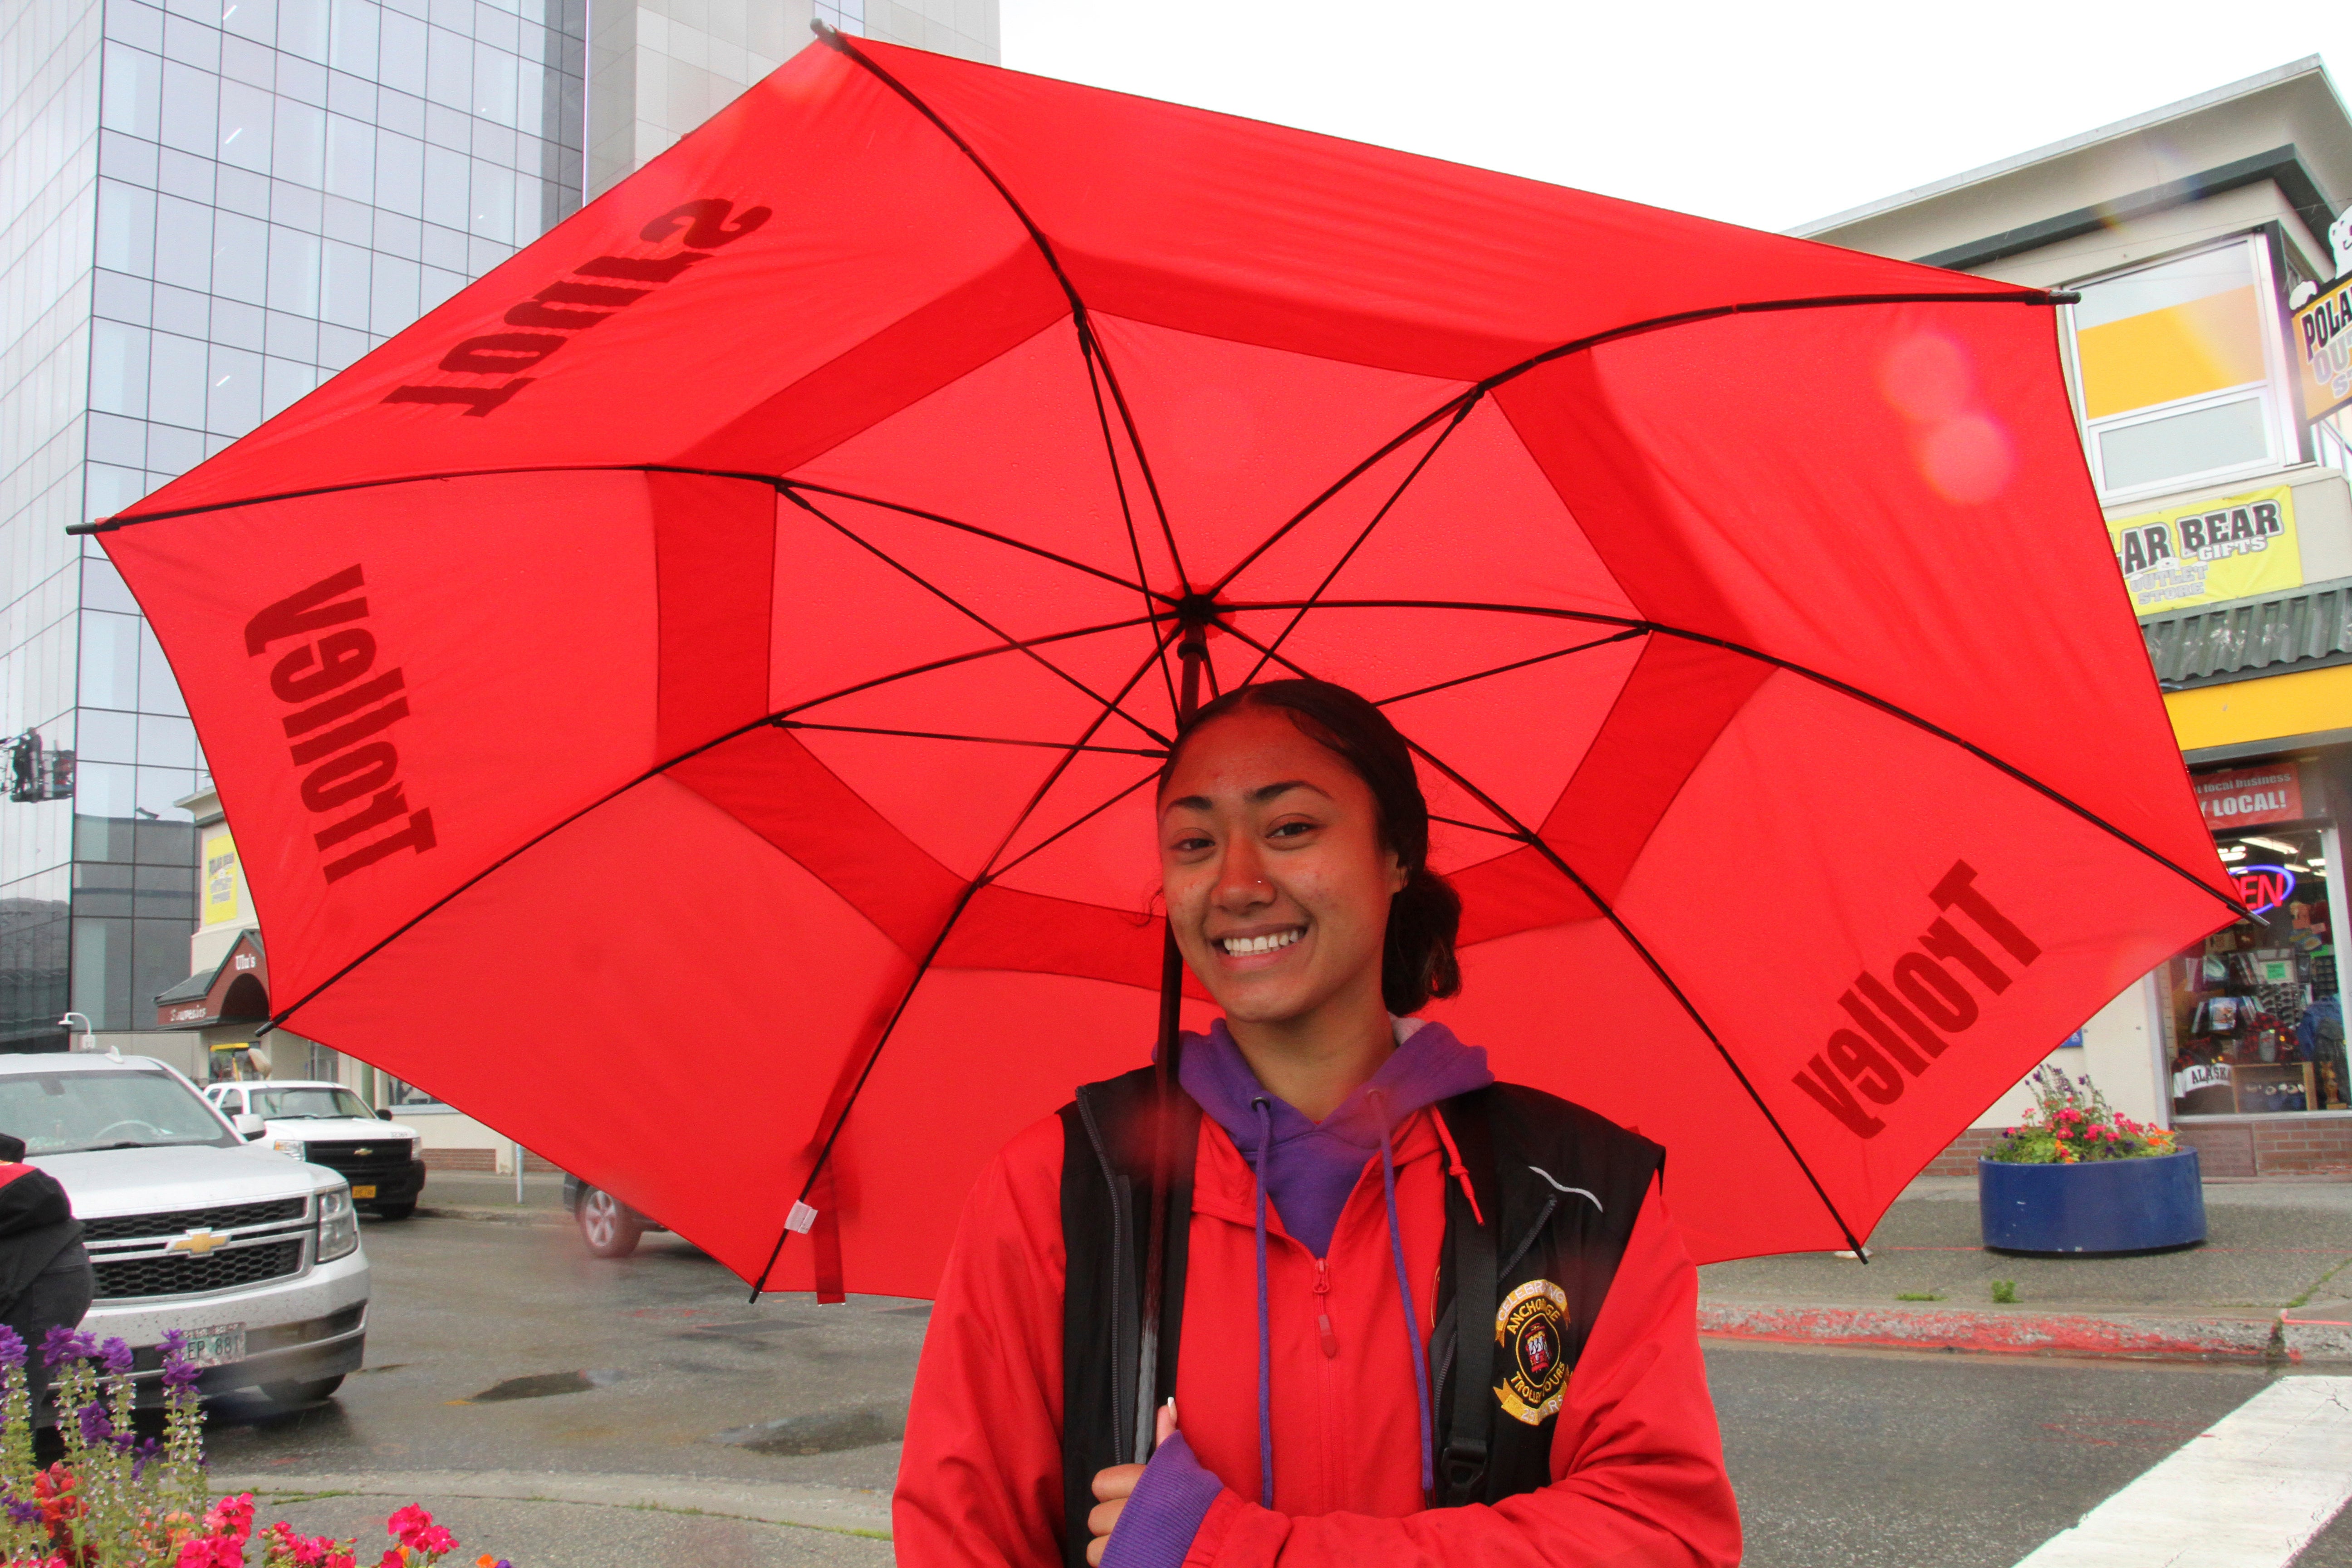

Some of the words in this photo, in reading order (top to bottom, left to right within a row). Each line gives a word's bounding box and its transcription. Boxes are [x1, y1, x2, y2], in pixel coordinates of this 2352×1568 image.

[2301, 287, 2352, 363] POLA
[2118, 524, 2174, 576] AR
[2178, 501, 2281, 554] BEAR
[2198, 535, 2267, 561] GIFTS
[2130, 565, 2208, 592] OUTLET
[2138, 582, 2205, 605] STORE
[2204, 780, 2234, 793] local
[2235, 774, 2291, 789] business
[2212, 790, 2287, 817] LOCAL!
[2232, 873, 2284, 910] EN
